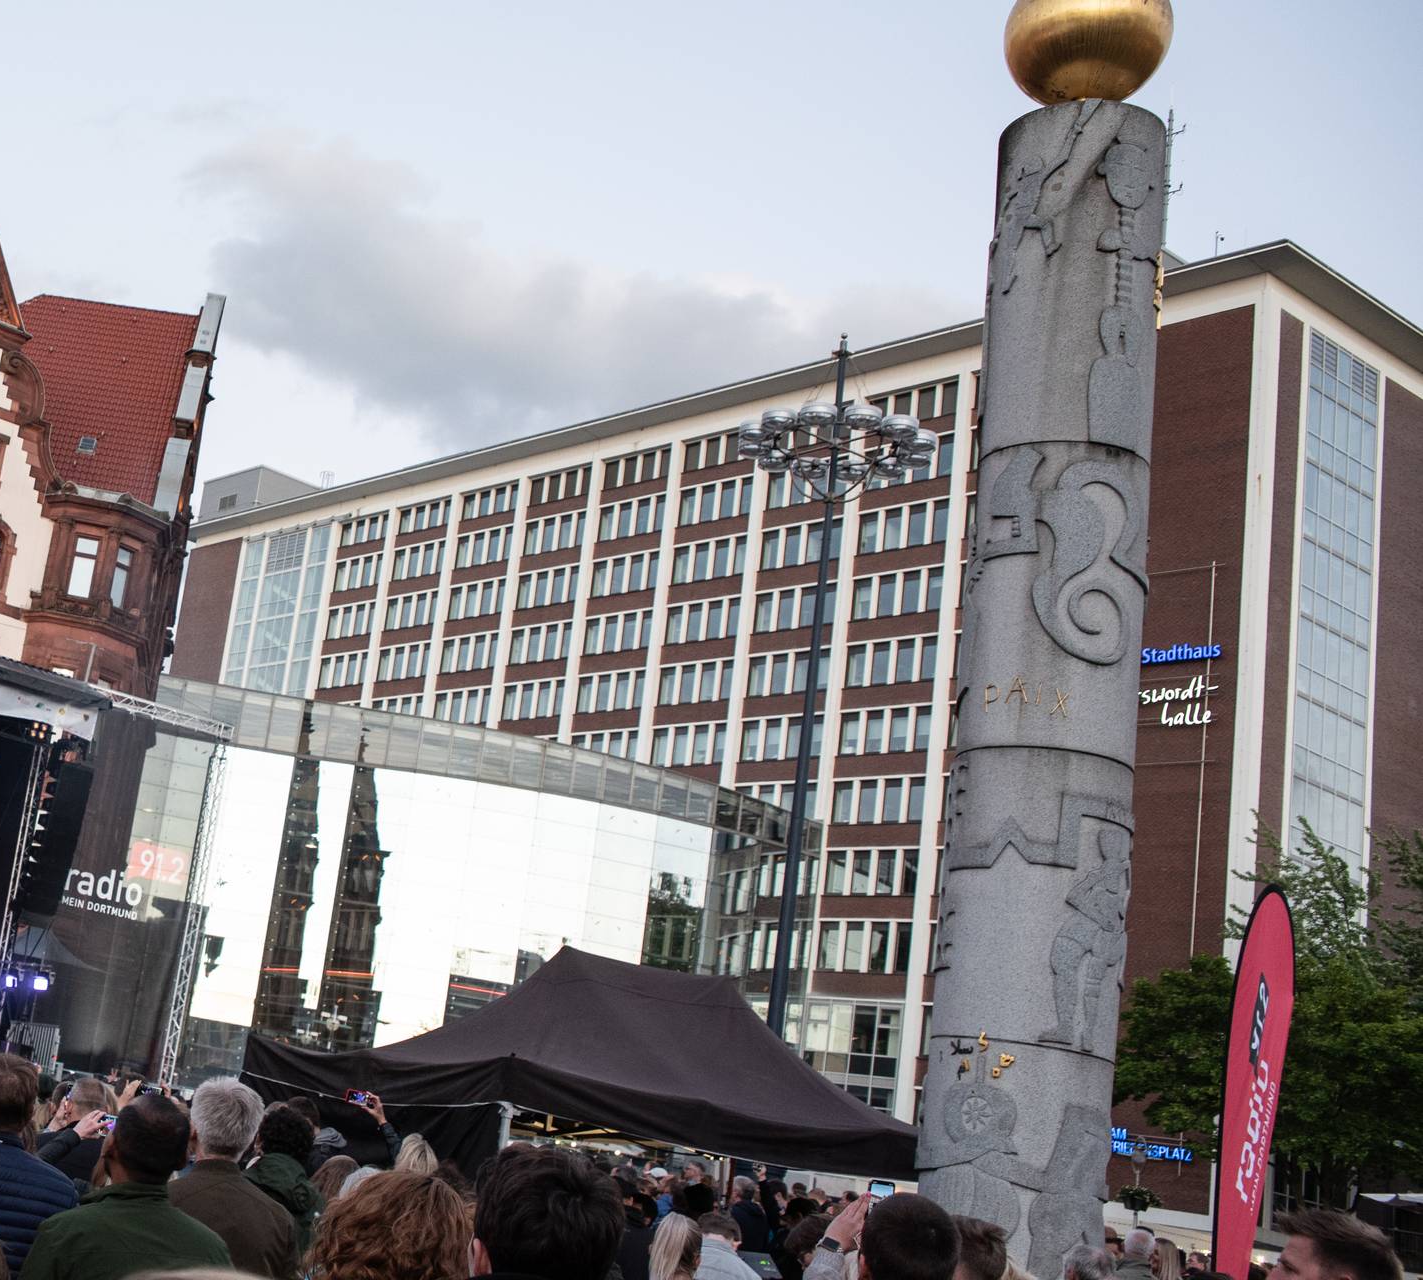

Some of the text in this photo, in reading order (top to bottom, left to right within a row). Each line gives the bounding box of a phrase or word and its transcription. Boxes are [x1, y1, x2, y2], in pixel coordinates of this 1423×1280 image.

[1141, 642, 1222, 665] Stadthaus
[1137, 674, 1220, 705] swordt-
[1161, 703, 1212, 727] halle
[63, 851, 185, 906] radio 91.2
[61, 895, 138, 921] MEIN DORTMUND
